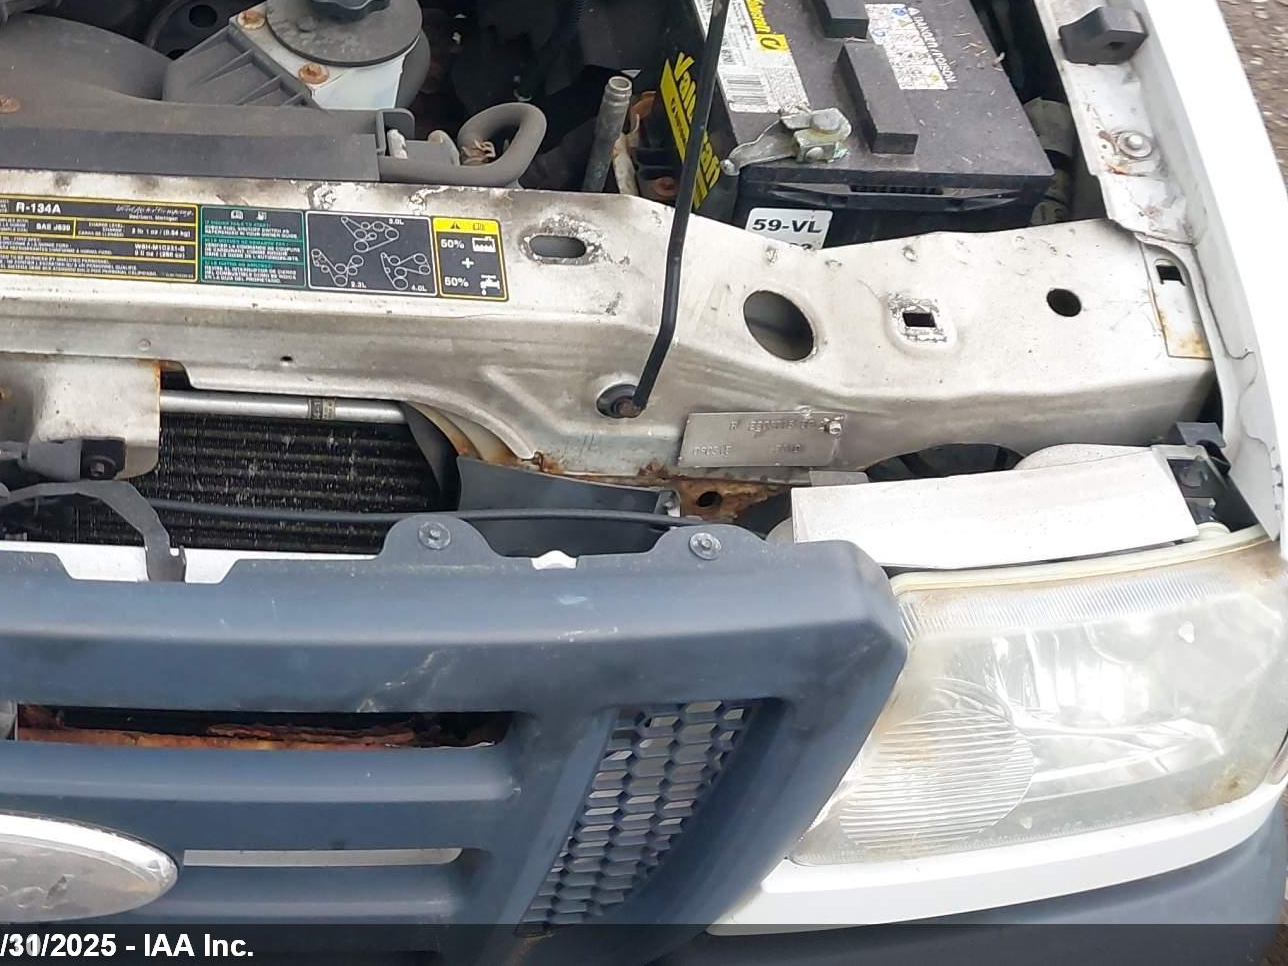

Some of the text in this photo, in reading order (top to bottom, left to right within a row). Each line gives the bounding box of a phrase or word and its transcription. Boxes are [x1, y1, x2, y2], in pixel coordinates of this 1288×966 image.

[15, 201, 62, 215] R-134A
[752, 218, 822, 234] 59-VL
[440, 238, 465, 249] 50%
[444, 276, 469, 287] 50%
